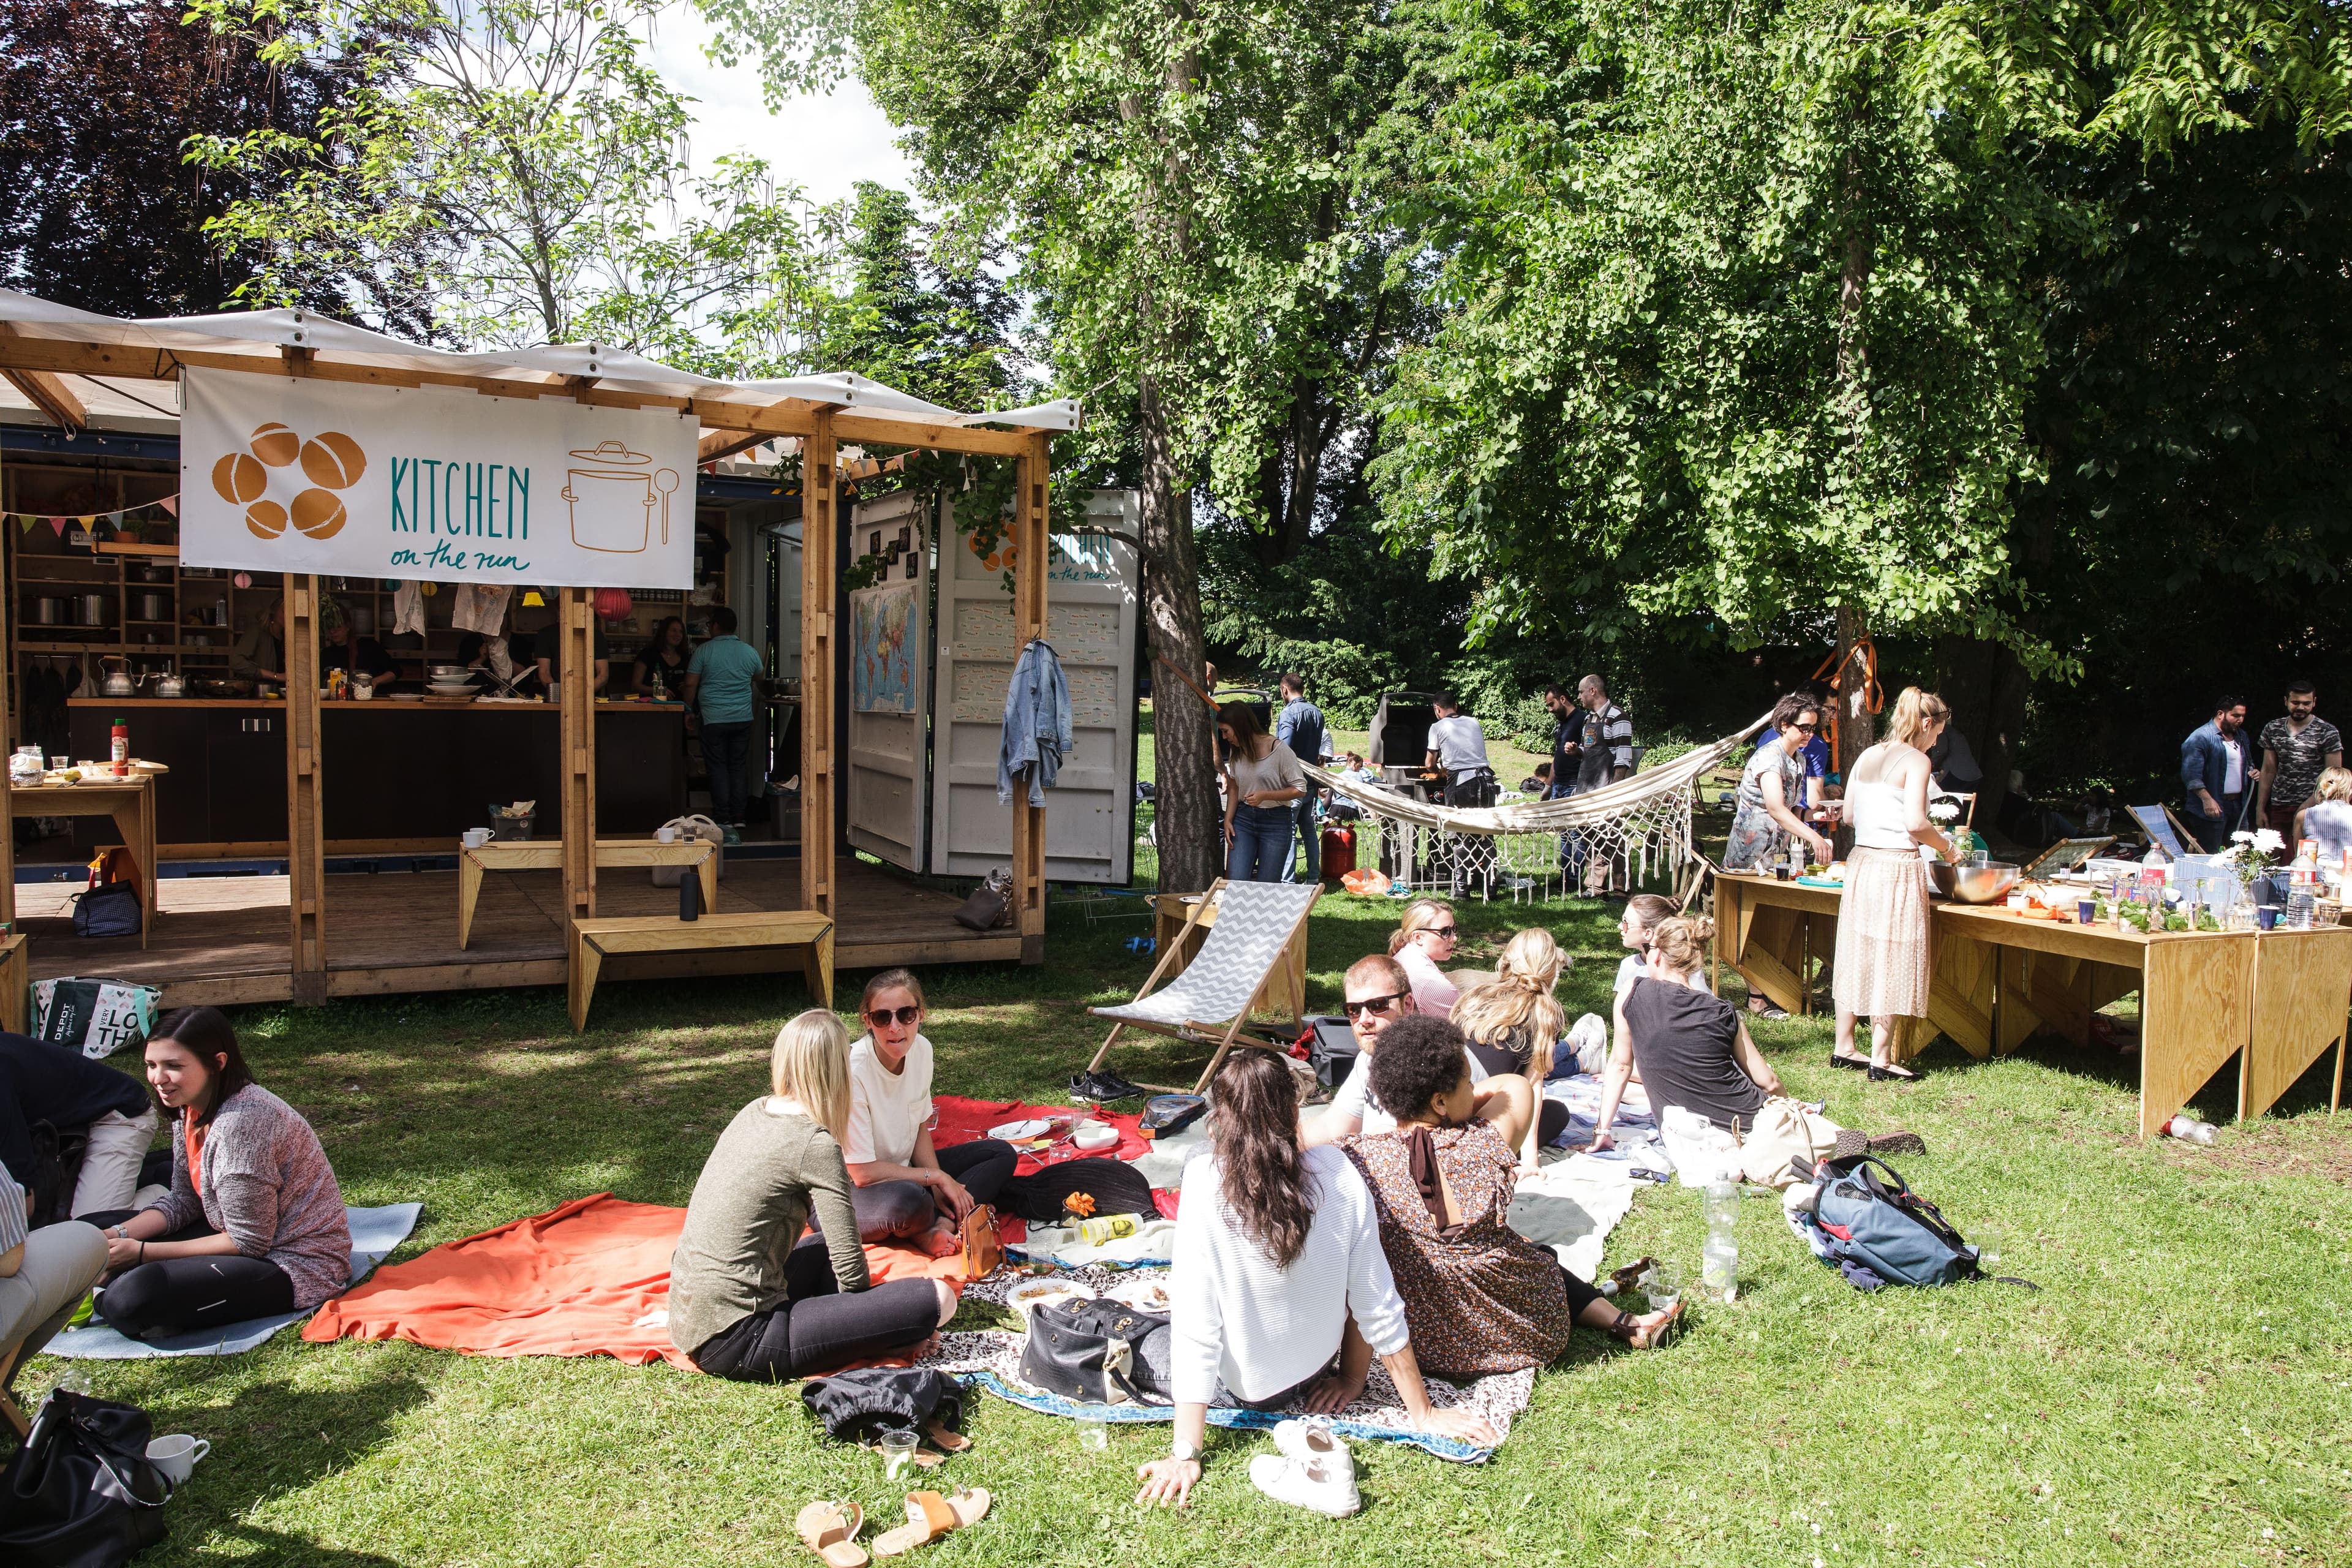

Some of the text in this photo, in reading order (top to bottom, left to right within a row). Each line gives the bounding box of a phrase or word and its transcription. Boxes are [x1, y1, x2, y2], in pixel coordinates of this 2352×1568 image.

[391, 456, 530, 540] KITCHEN
[391, 538, 530, 571] on the run
[1059, 565, 1080, 581] the
[1084, 570, 1110, 581] run
[54, 1003, 70, 1040] DEPOT
[100, 1008, 110, 1025] VERY
